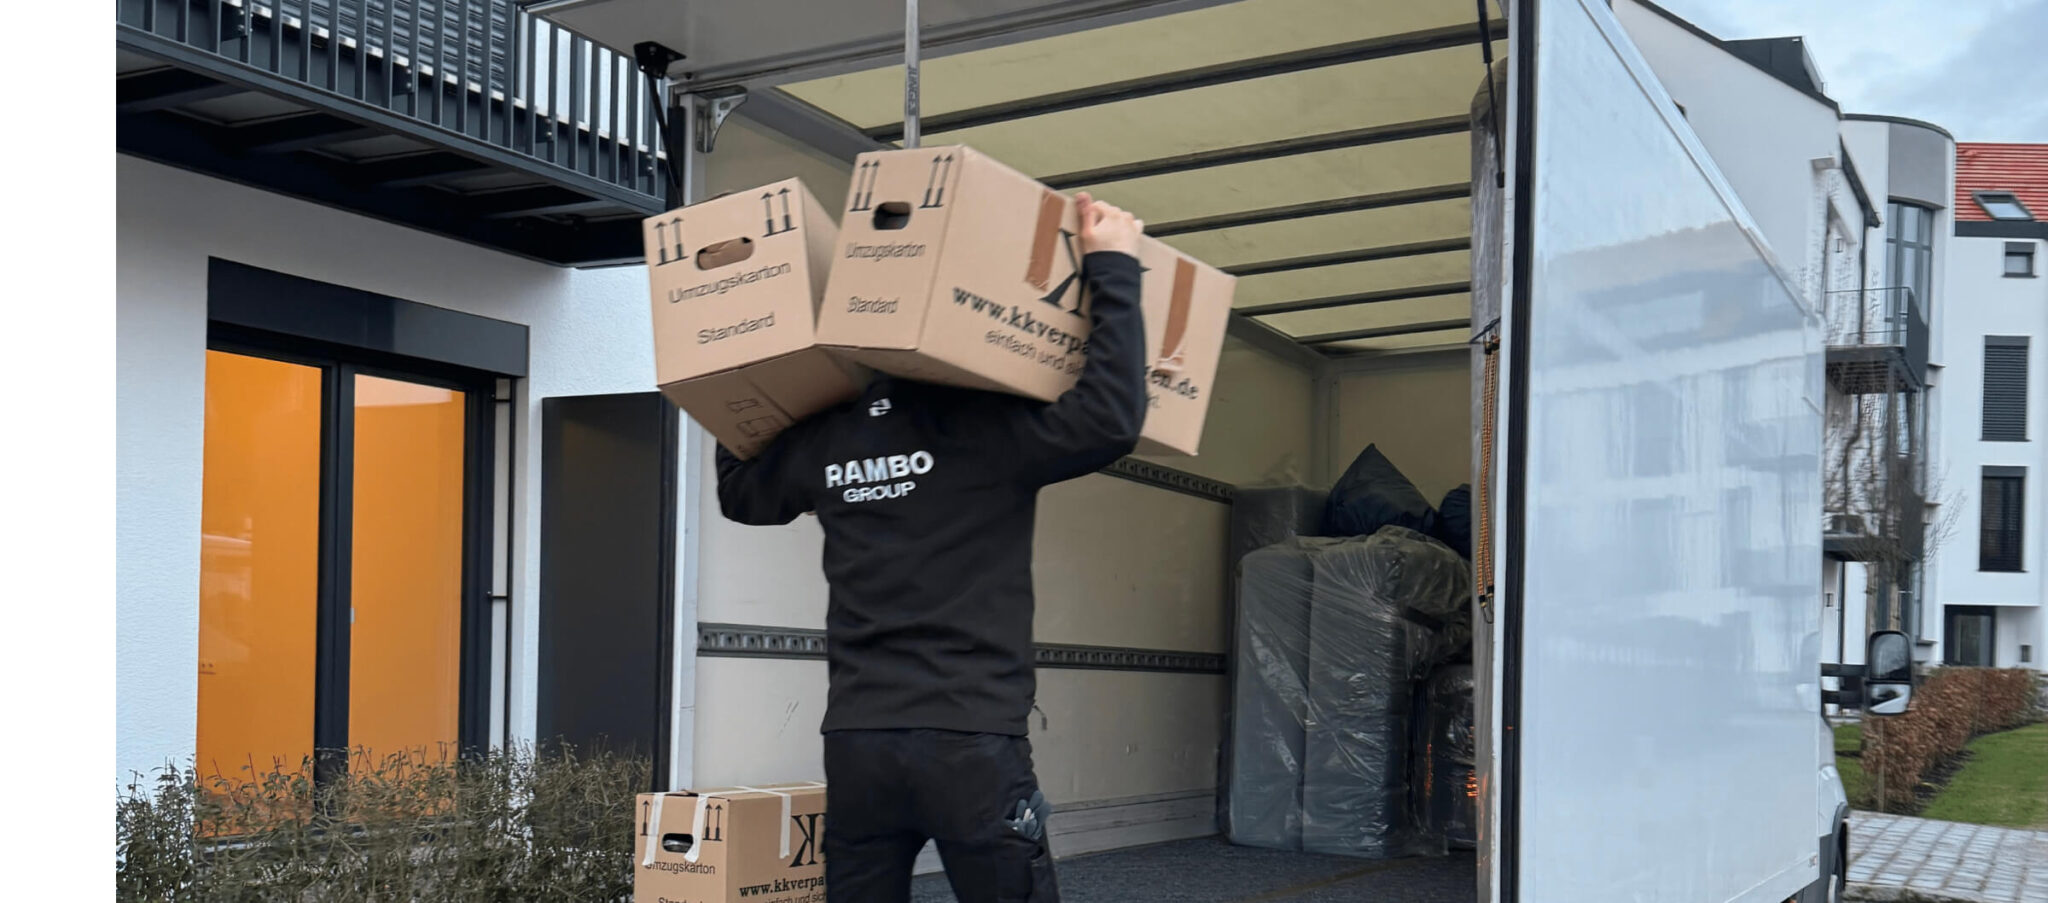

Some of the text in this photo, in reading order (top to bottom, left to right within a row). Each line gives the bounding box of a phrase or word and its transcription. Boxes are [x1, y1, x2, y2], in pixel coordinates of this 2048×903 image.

[845, 241, 926, 262] Umzugskarton
[668, 262, 791, 303] Umzugskarton
[846, 296, 900, 314] Standard
[697, 312, 776, 344] Standard
[824, 450, 935, 488] RAMBO
[842, 481, 916, 503] GROUP
[739, 876, 825, 898] www.kkverpa
